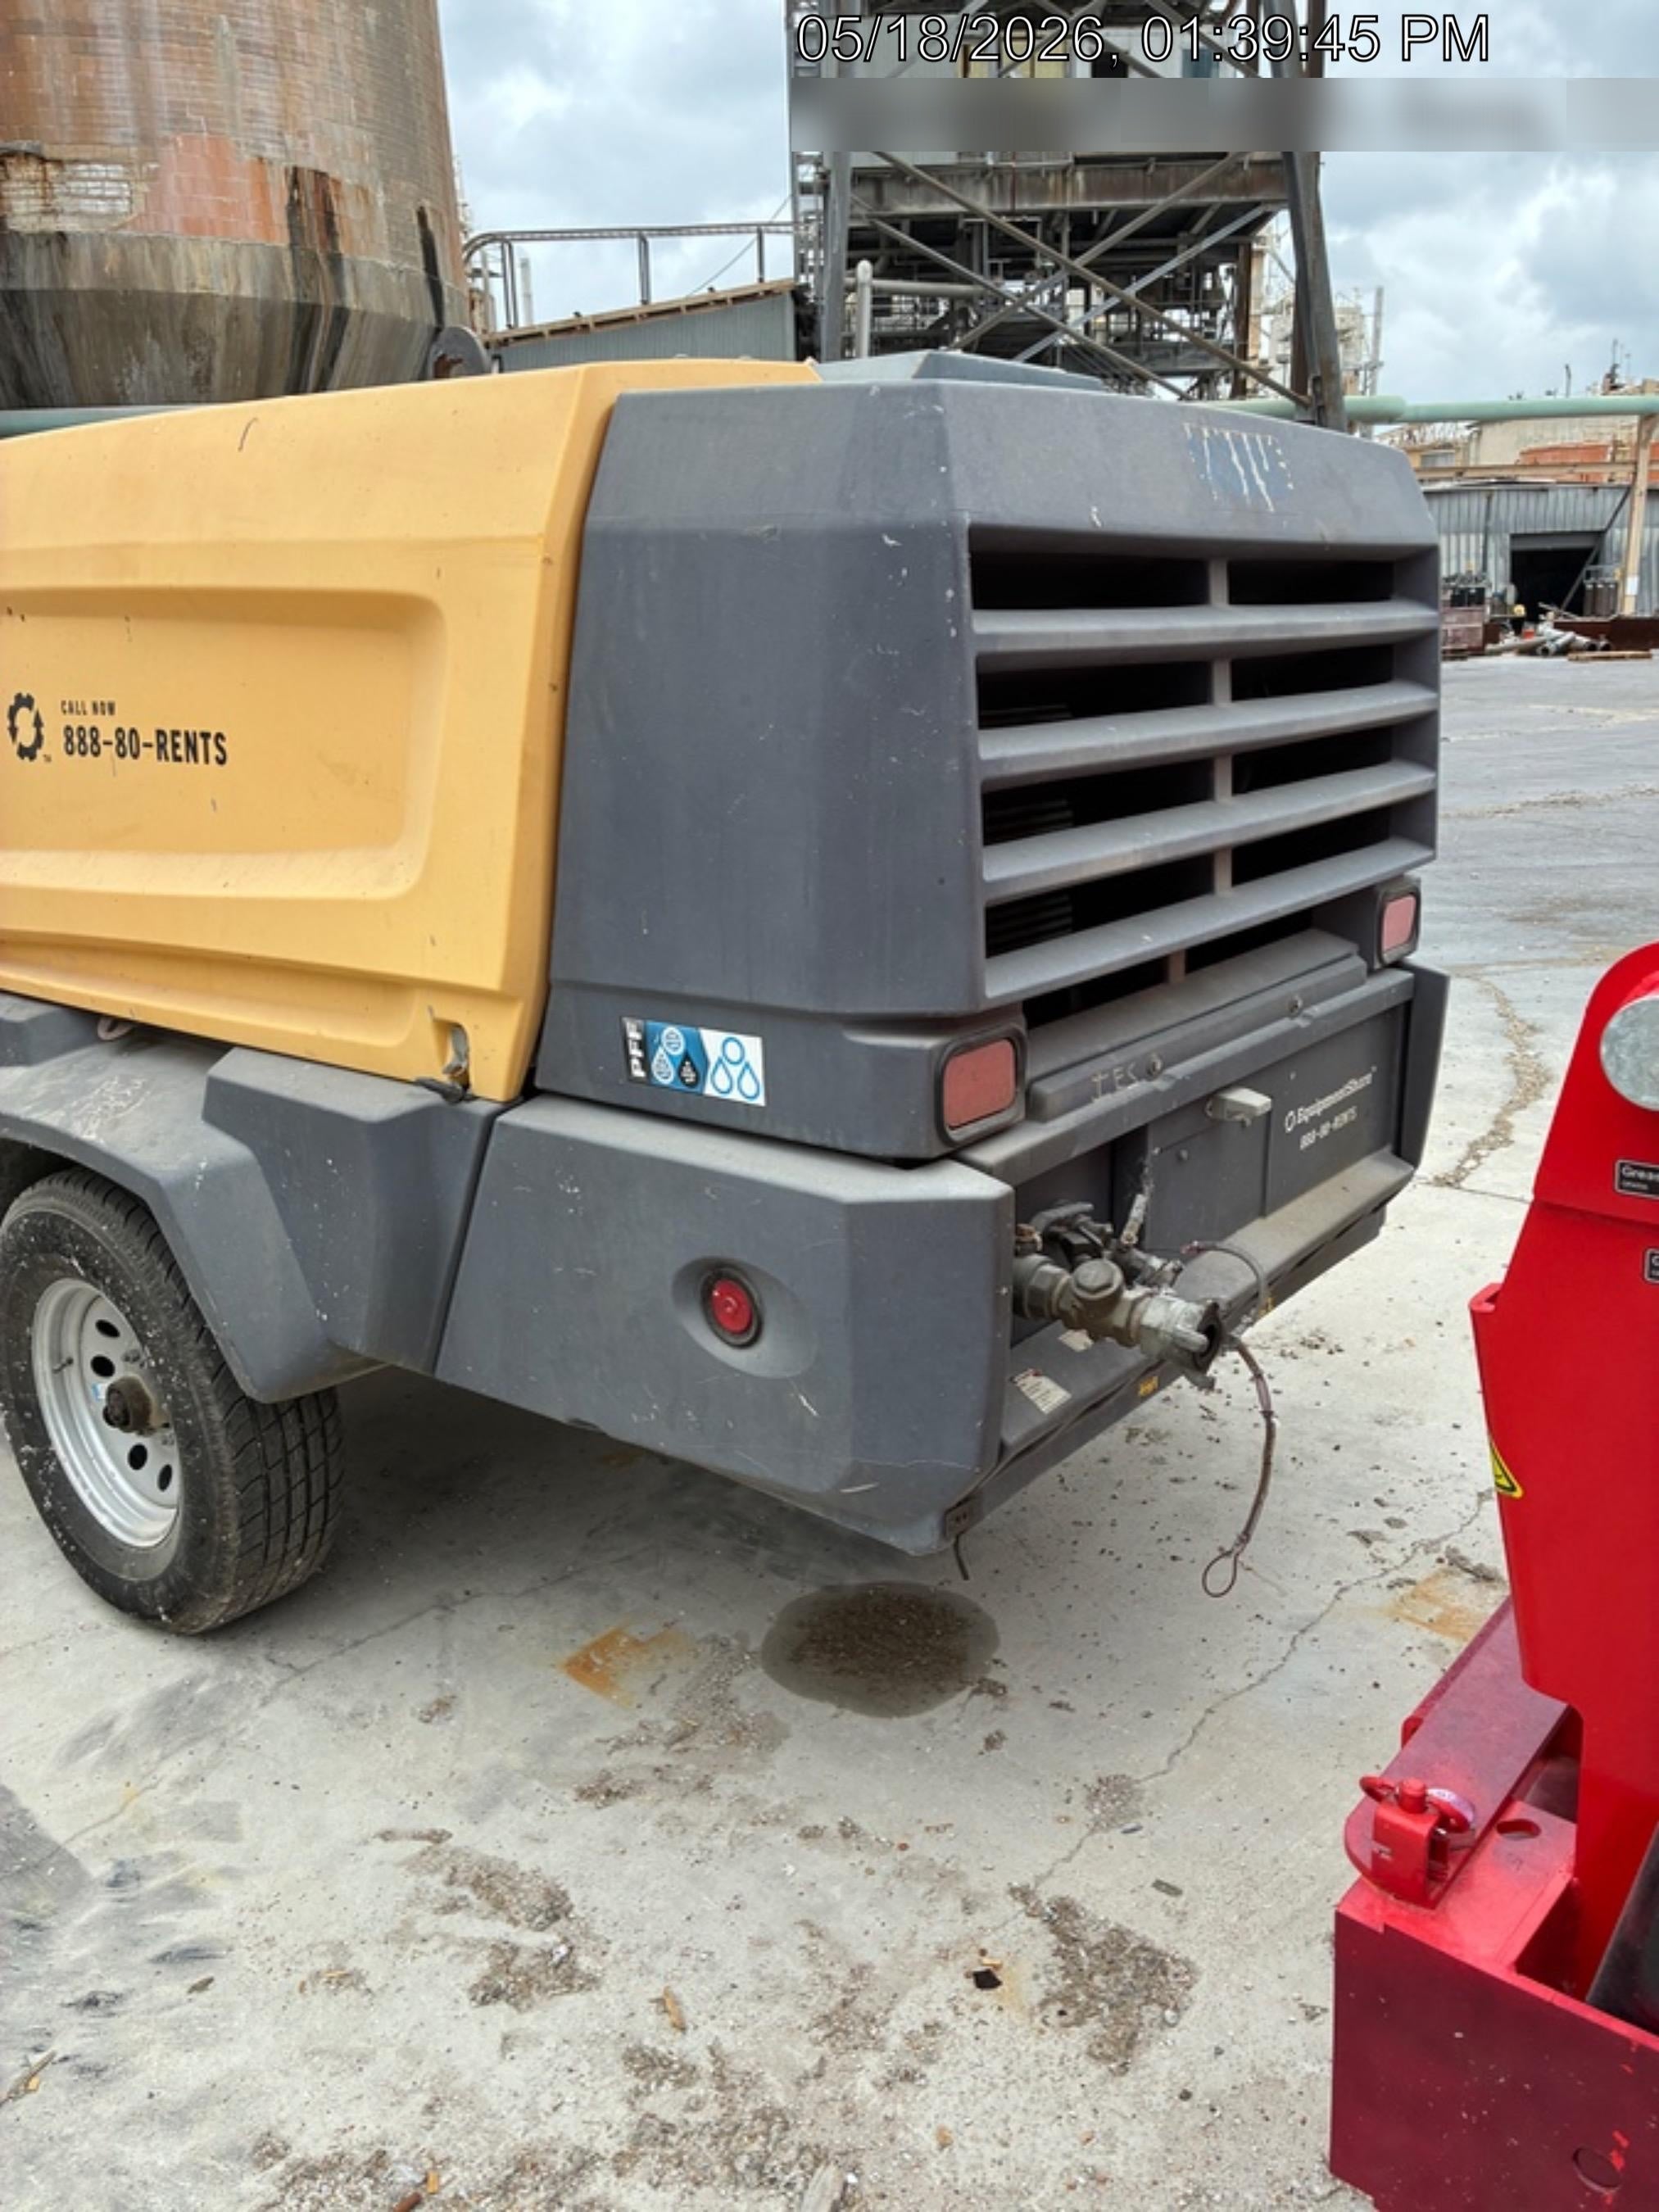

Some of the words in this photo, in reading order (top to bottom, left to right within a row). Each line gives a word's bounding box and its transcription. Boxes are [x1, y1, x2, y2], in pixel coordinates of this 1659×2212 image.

[61, 700, 88, 716] CALL
[92, 700, 116, 717] NOW
[63, 724, 228, 767] 888-80-RENTS
